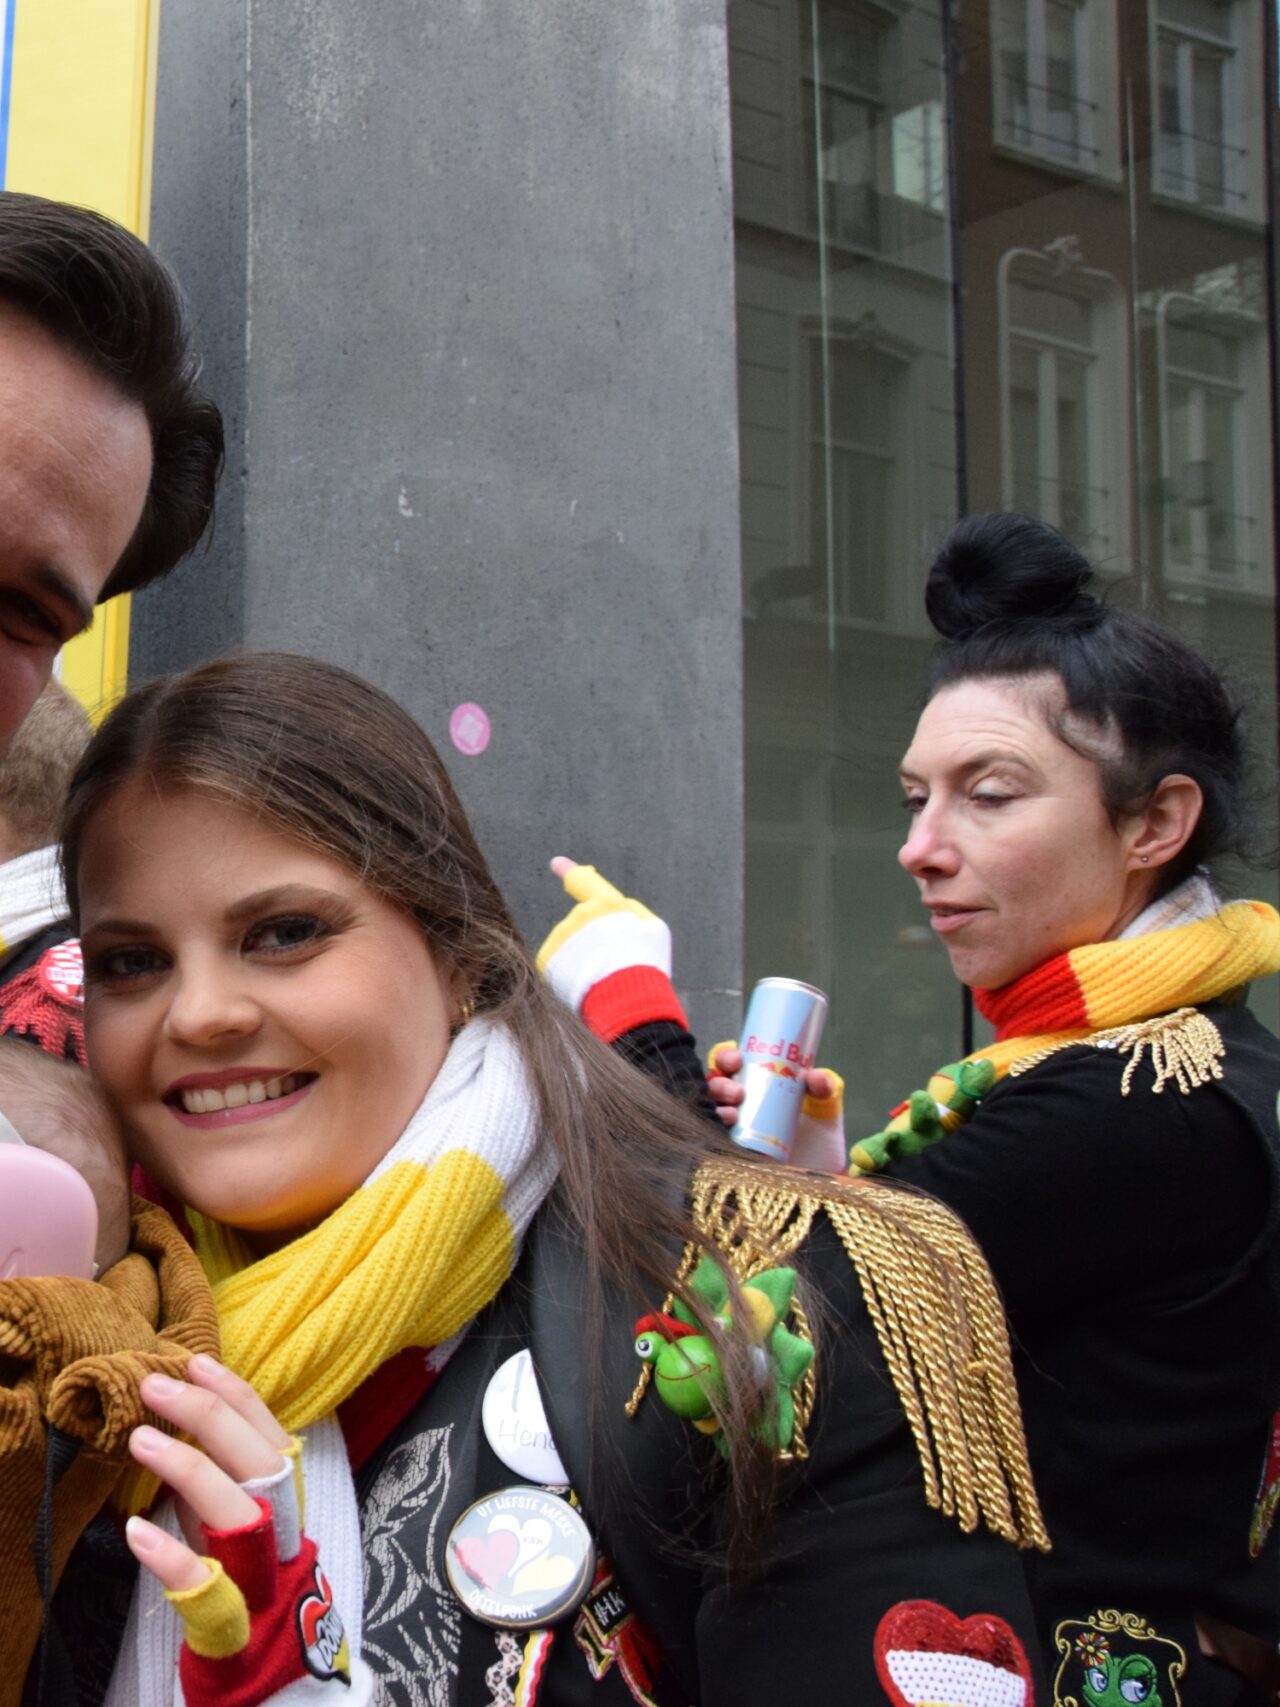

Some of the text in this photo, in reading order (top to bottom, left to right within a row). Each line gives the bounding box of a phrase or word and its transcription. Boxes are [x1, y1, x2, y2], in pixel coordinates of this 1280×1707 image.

[746, 1036, 815, 1068] Red Bu
[494, 1495, 541, 1511] LIEFSTE
